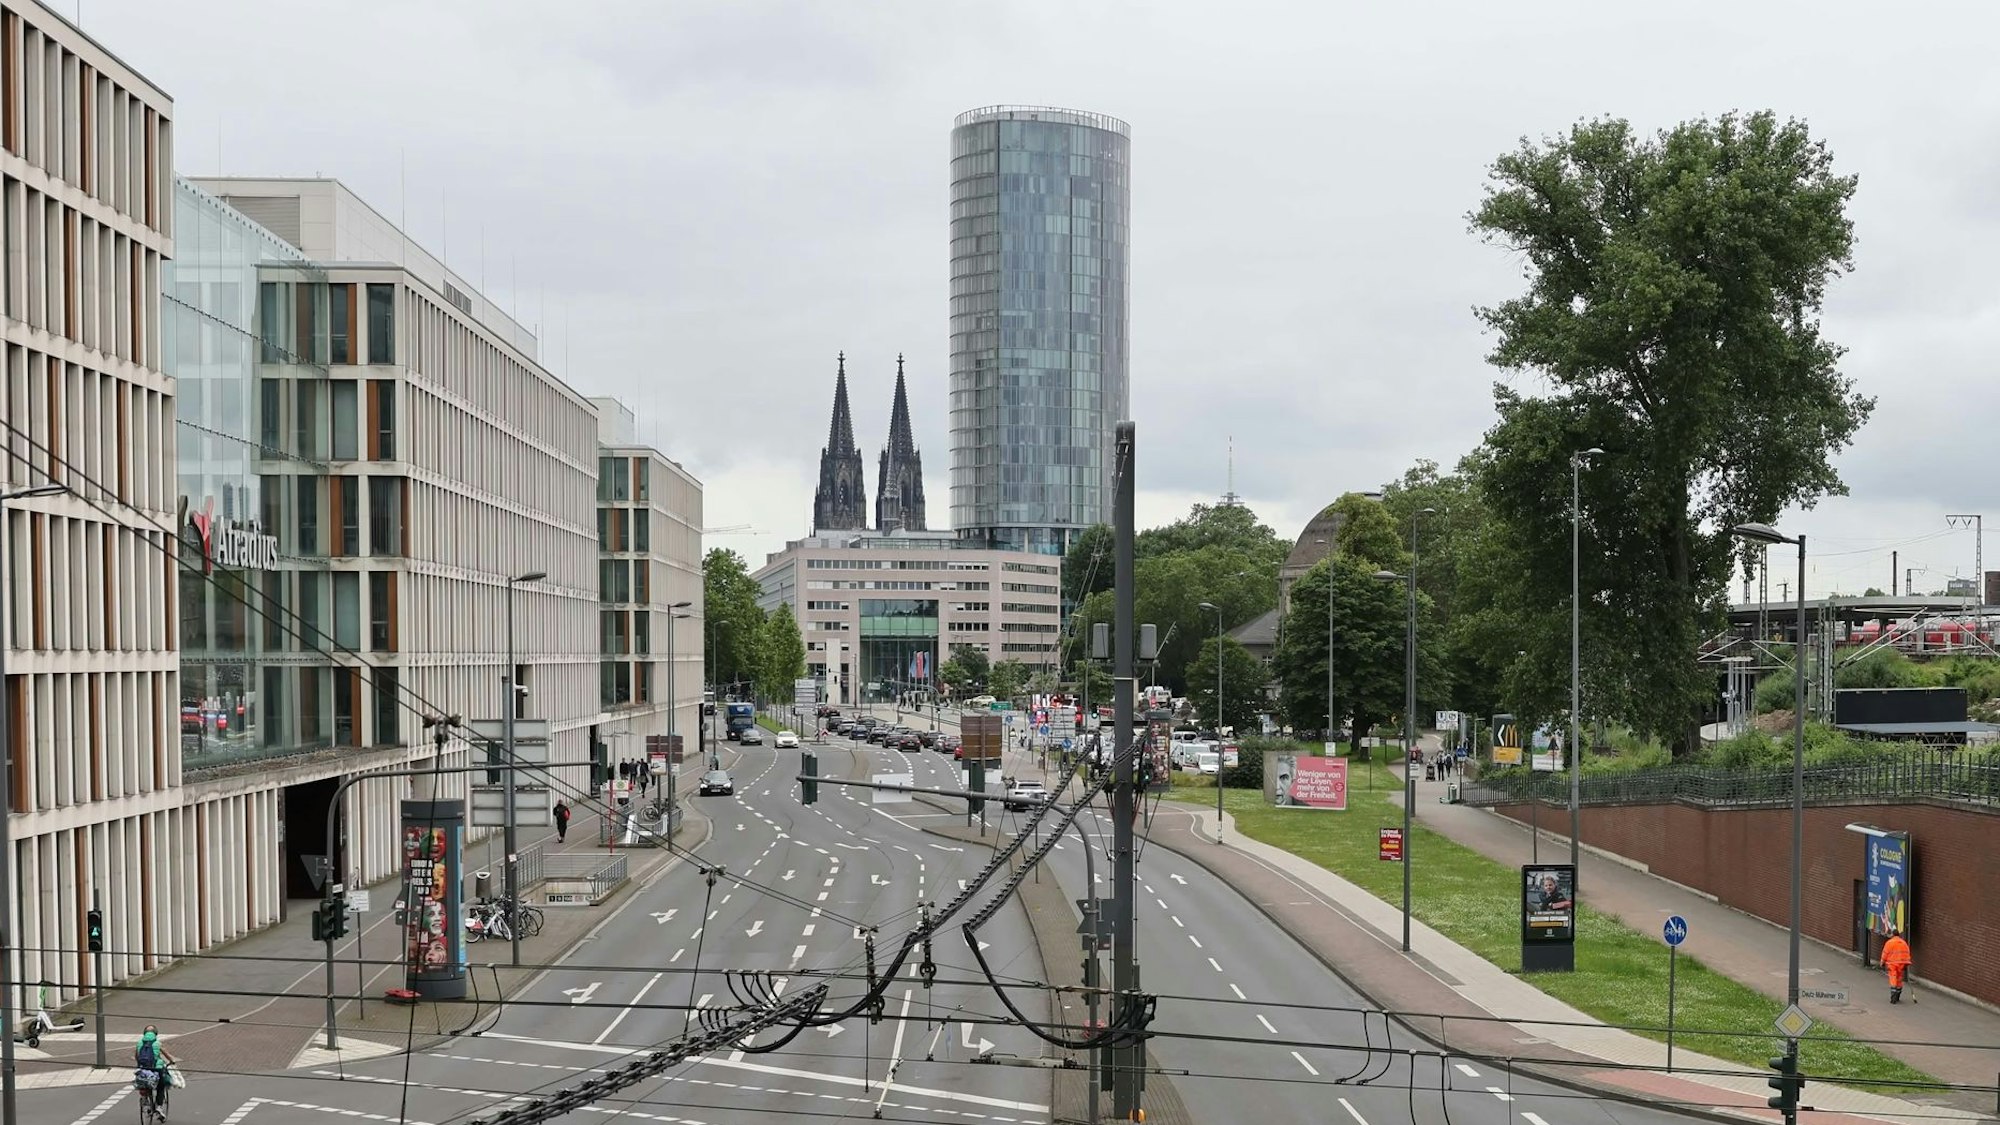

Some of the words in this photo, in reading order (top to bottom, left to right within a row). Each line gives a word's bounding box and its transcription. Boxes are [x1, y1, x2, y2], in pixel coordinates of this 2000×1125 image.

[216, 514, 278, 572] Atradius
[1297, 769, 1326, 778] Weniger
[1296, 784, 1315, 792] mehr
[1309, 791, 1337, 799] Freiheit.
[1880, 847, 1902, 862] COLOGNE
